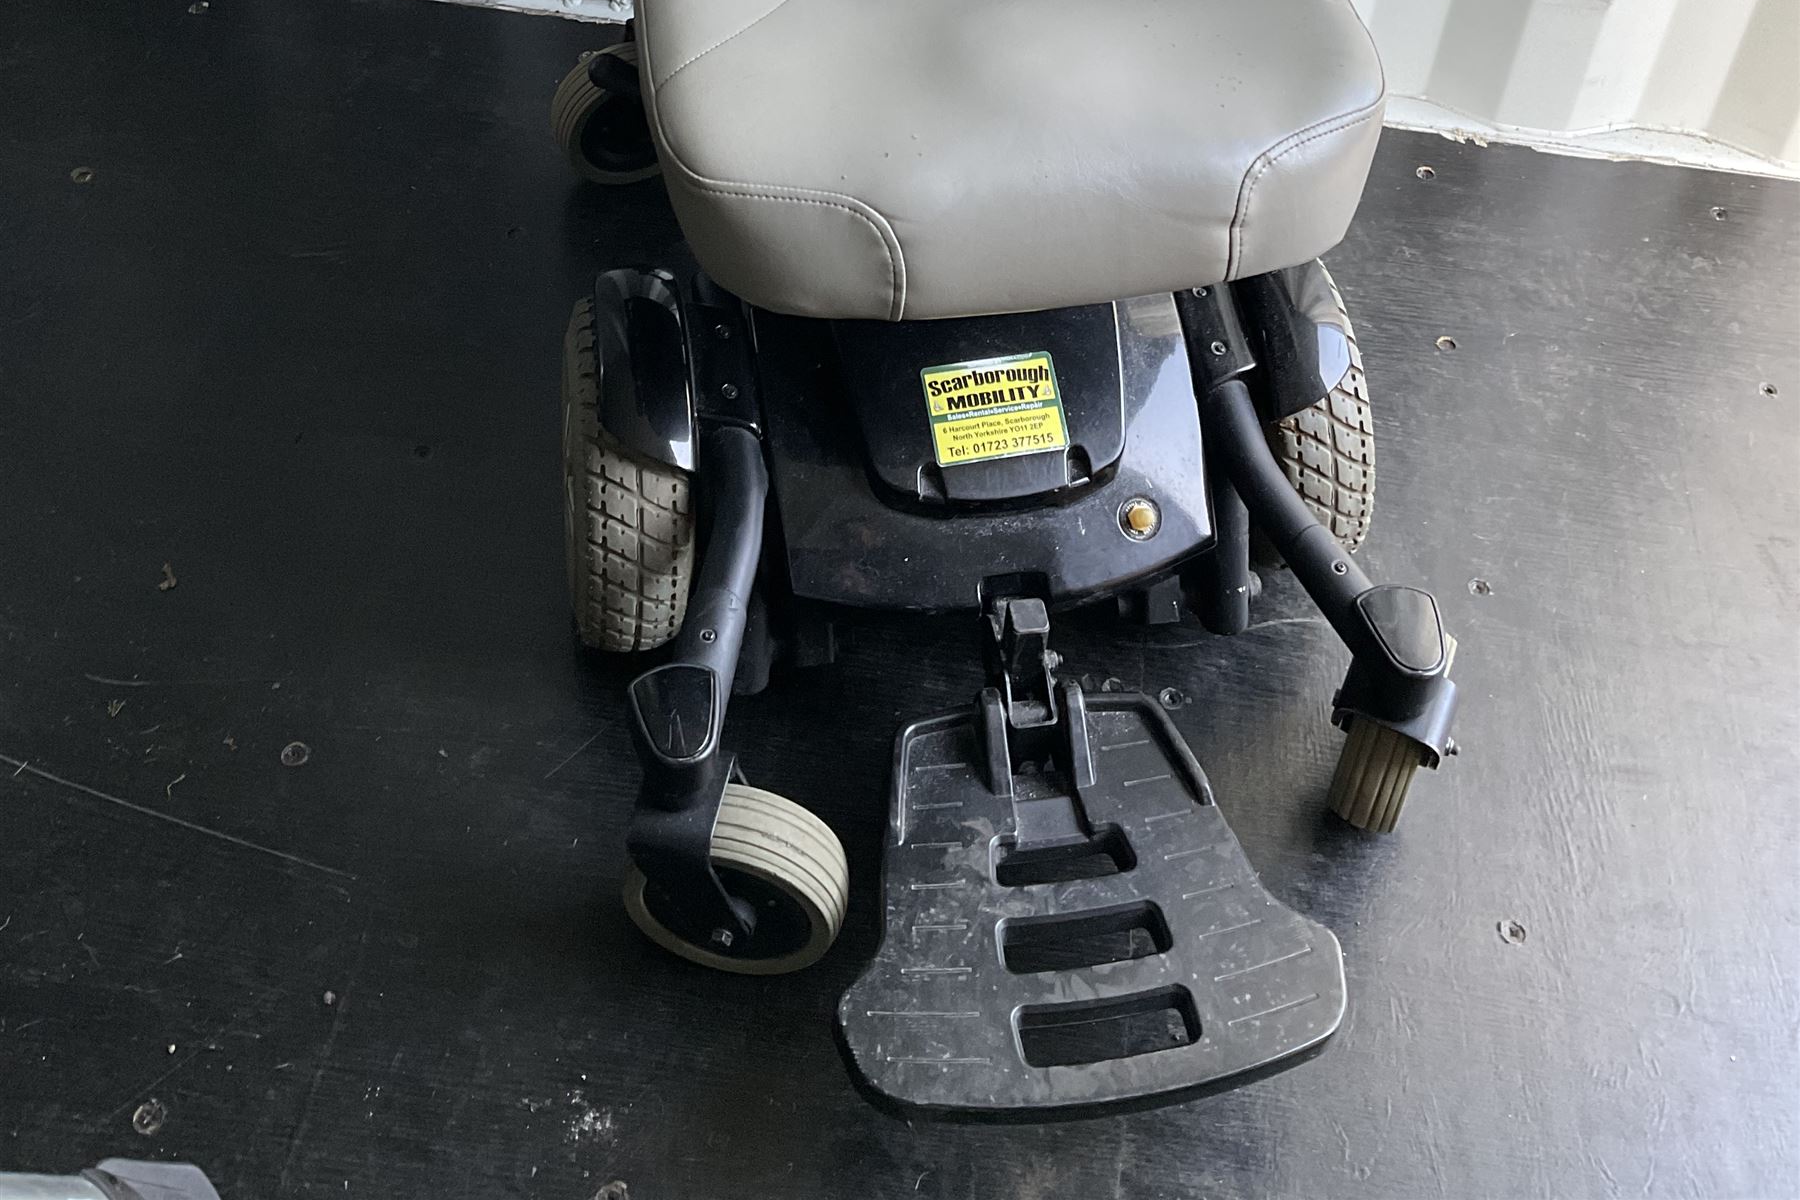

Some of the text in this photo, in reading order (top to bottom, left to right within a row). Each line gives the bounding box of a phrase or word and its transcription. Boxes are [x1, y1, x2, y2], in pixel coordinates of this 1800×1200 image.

[928, 366, 1049, 397] Scarborough
[946, 385, 1040, 411] MOBILITY
[949, 423, 980, 434] Harcourt
[982, 420, 1003, 430] Place,
[1005, 413, 1050, 425] Scarborough
[953, 432, 973, 441] North
[974, 427, 1008, 438] Yorkshire
[1009, 424, 1028, 433] YO11
[948, 433, 1054, 457] Tel: 01723 377515
